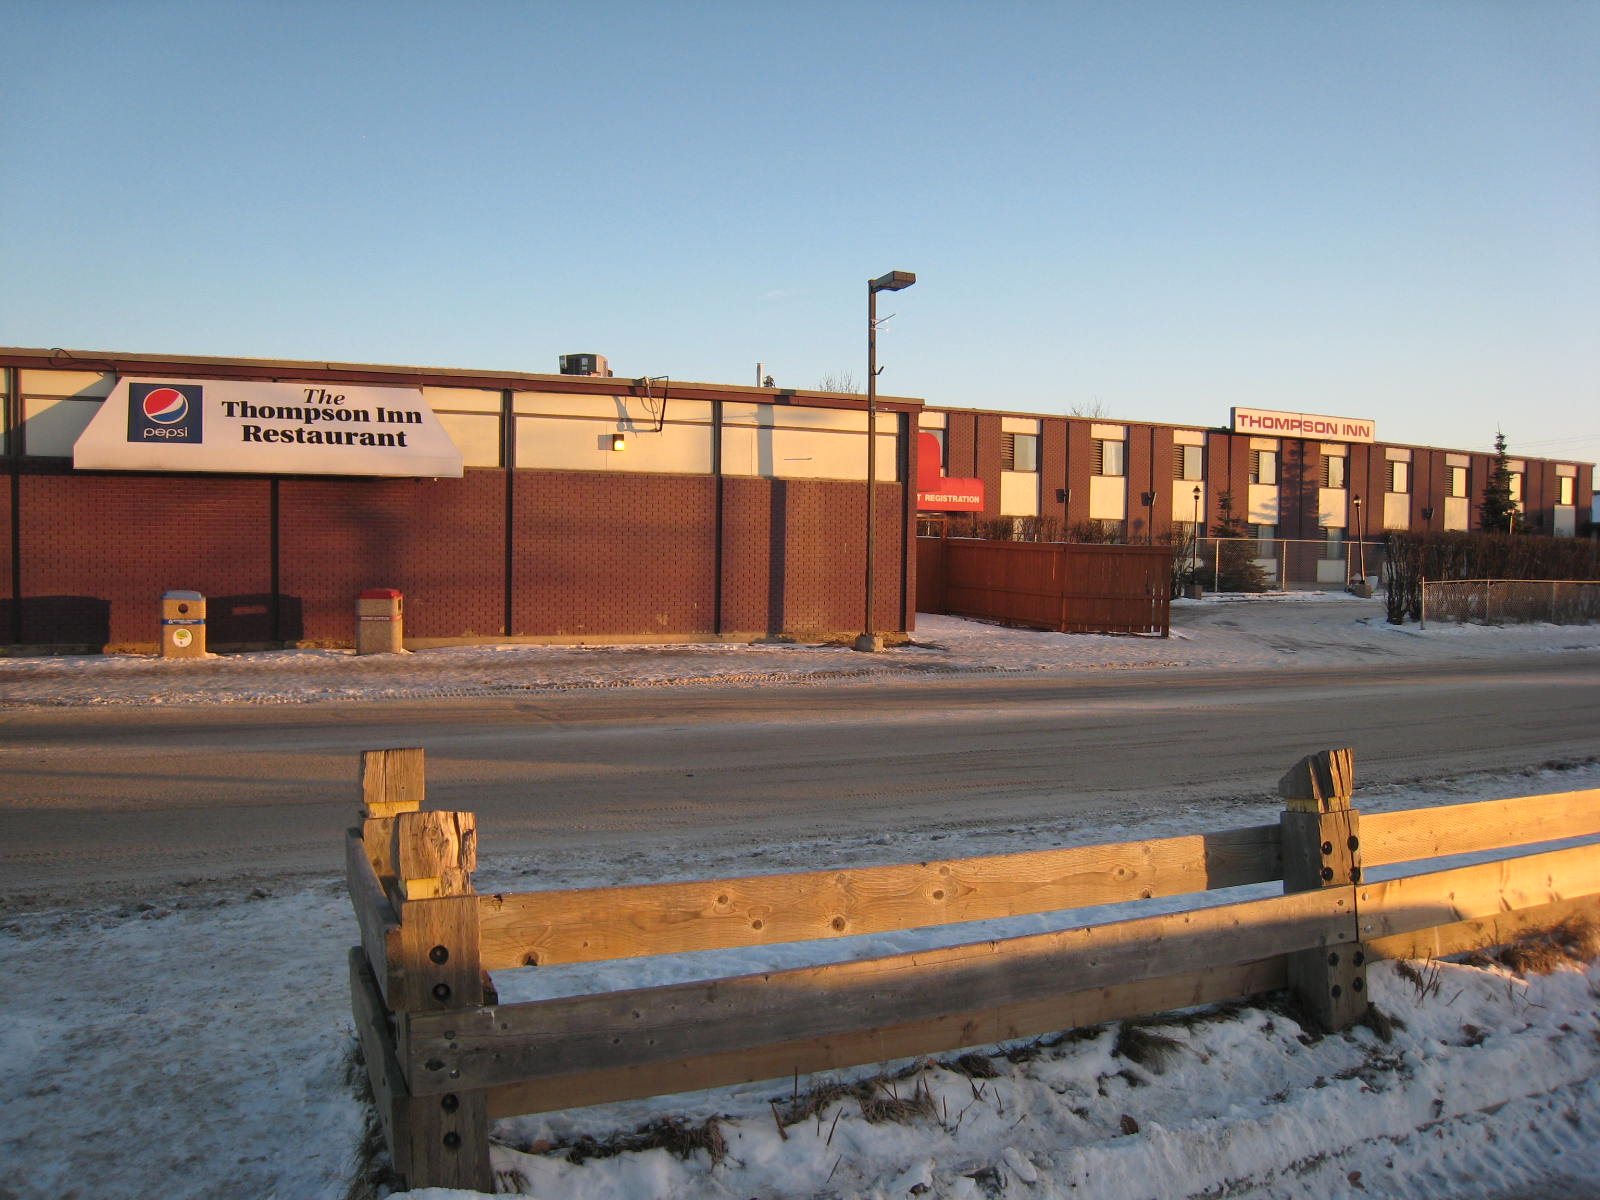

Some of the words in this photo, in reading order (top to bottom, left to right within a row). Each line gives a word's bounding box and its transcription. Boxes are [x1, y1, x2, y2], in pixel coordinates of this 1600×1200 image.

[303, 388, 346, 405] The
[221, 401, 370, 424] Thompson
[376, 407, 422, 423] Inn
[143, 426, 188, 438] pepsi
[241, 424, 408, 447] Restaurant
[1237, 414, 1338, 435] THOMPSON
[1342, 423, 1370, 437] INN
[925, 494, 980, 503] REGISTRATION
